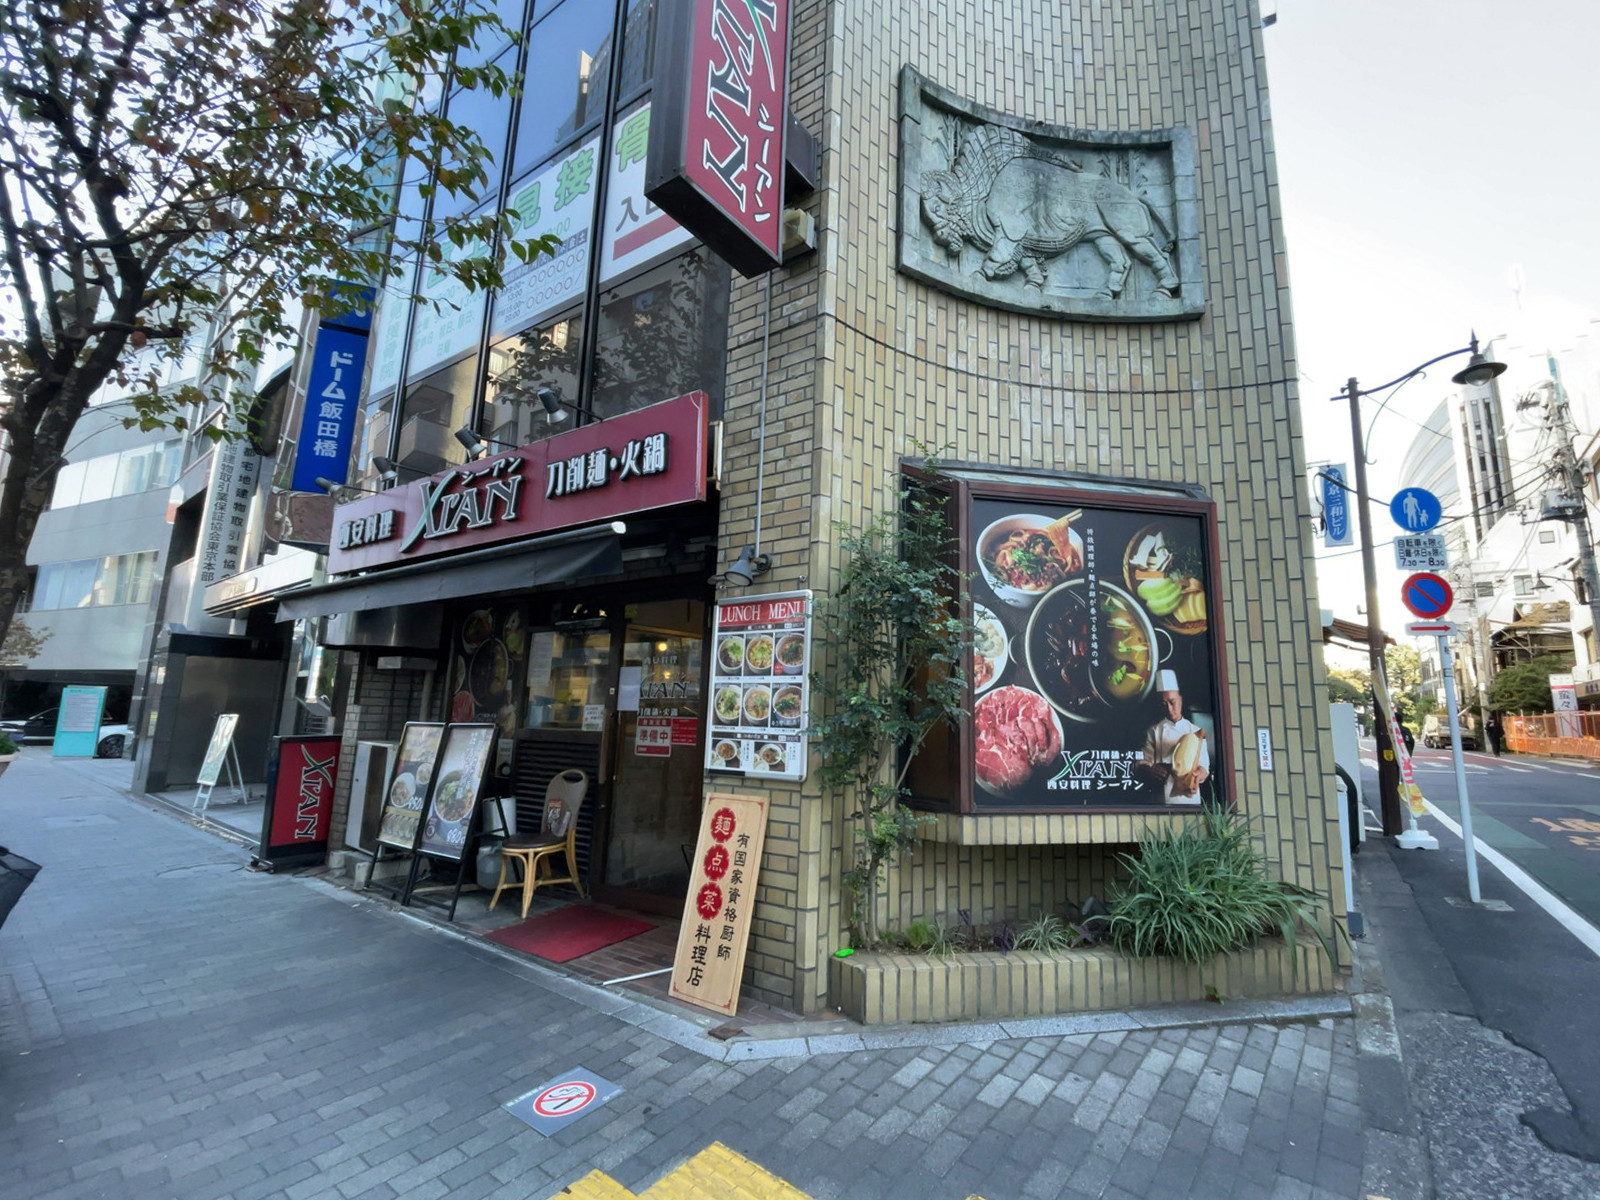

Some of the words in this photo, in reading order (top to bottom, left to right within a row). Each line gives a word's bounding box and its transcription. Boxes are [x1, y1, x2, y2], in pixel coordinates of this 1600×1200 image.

[313, 350, 353, 458] ドーム飯田橋
[460, 455, 524, 487] シーアン
[338, 509, 396, 550] 西安料理
[719, 604, 761, 623] LUNCH
[768, 600, 806, 620] MENU
[1096, 779, 1144, 790] シーアン
[716, 832, 751, 962] 有国家資格厨師
